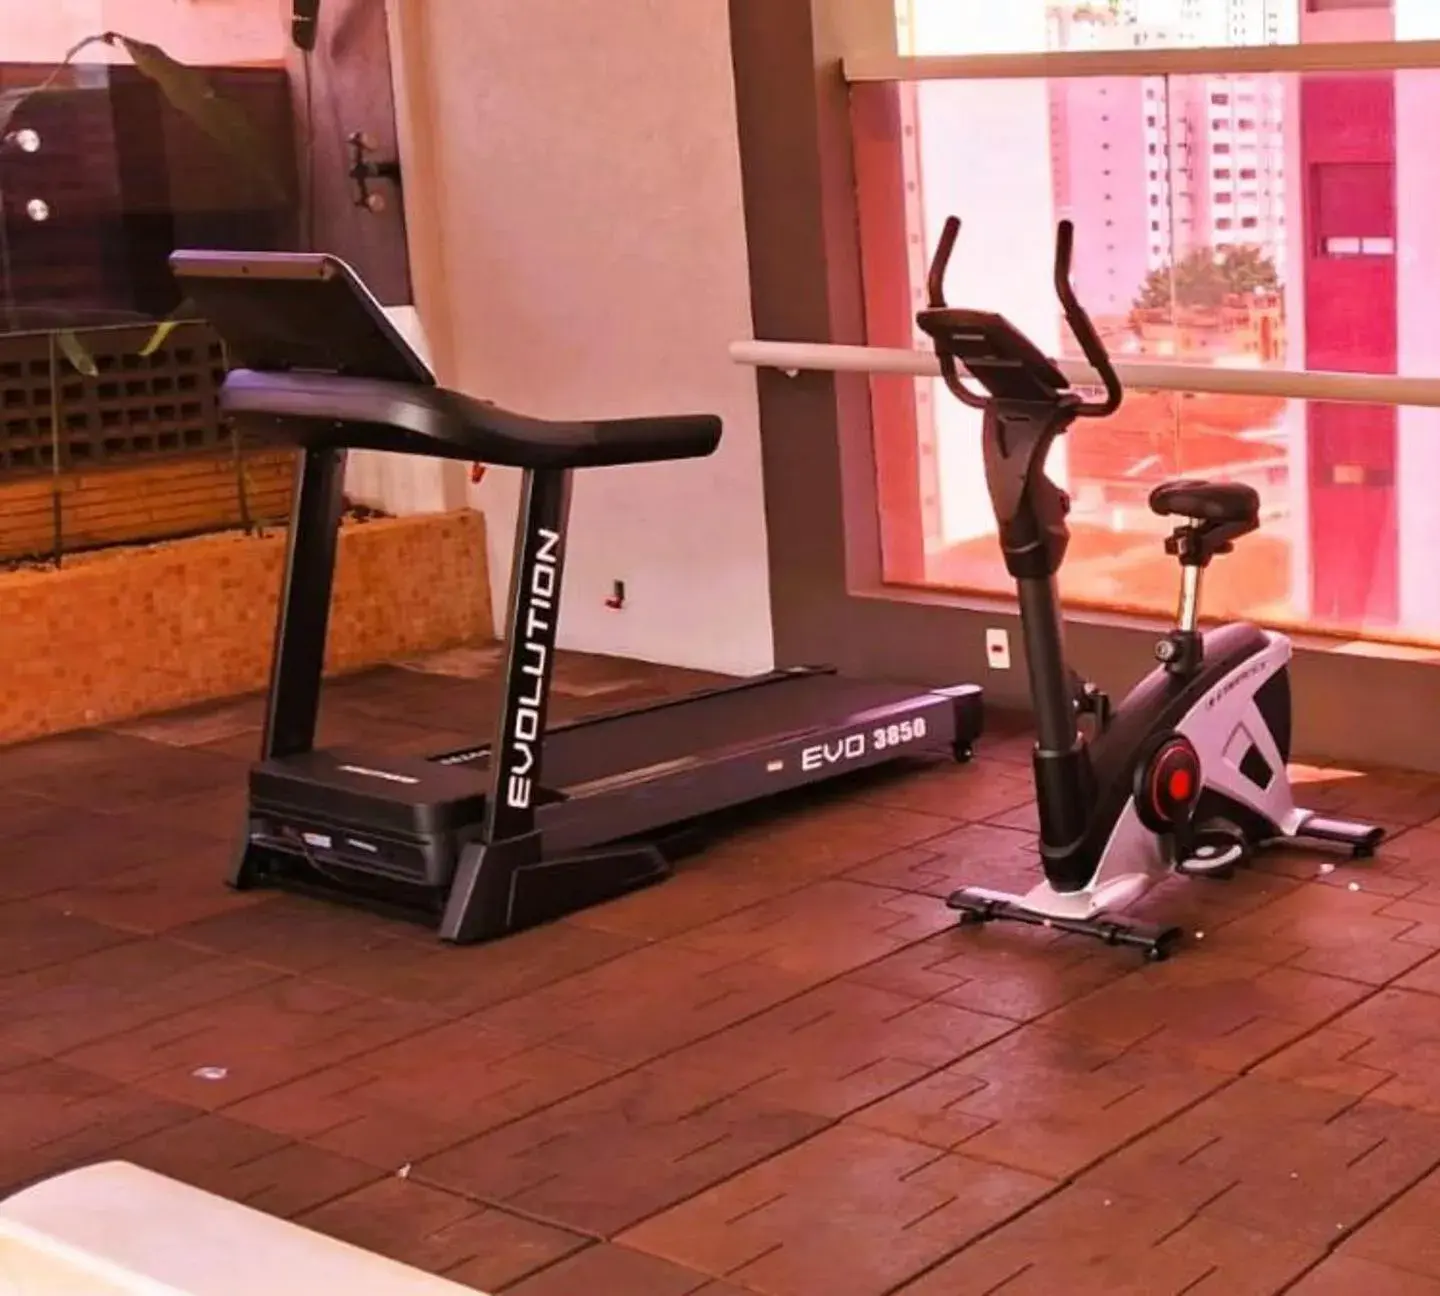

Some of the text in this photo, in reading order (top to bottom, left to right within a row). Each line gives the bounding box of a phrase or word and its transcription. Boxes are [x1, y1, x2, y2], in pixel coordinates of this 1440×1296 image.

[507, 528, 560, 810] EVOLUTION
[801, 716, 927, 772] EVO 3850
